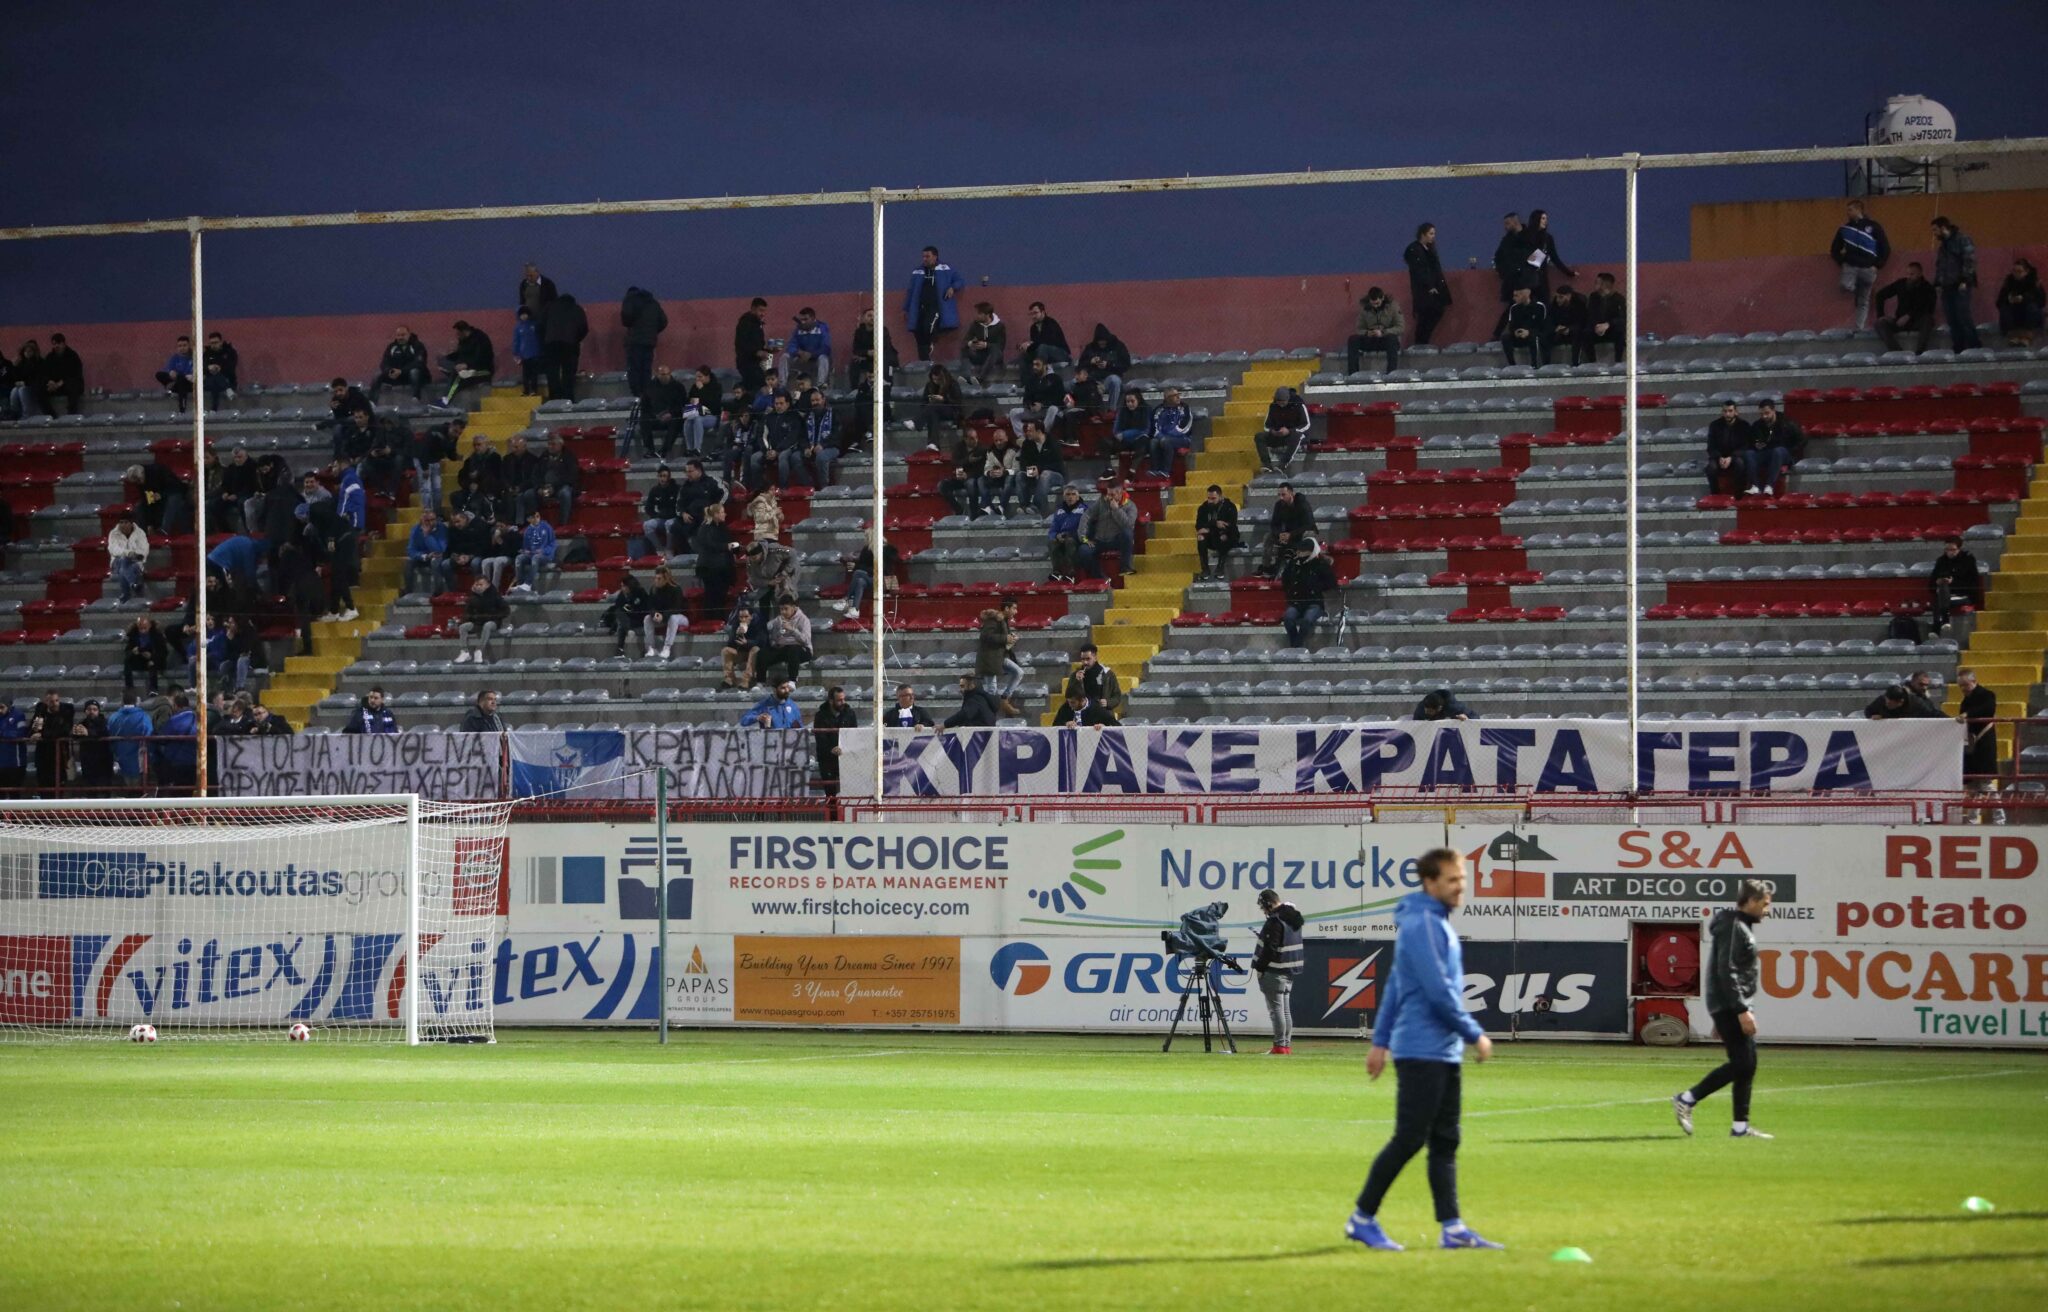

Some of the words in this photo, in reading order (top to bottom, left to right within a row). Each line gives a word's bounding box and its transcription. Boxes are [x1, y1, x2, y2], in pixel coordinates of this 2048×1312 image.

[883, 730, 1260, 796] ΚΥΡΙΑΚΕ
[1296, 728, 1598, 794] ΚΡΑΤΑ
[1638, 731, 1873, 796] ΓΕΡΑ
[730, 836, 1009, 870] FIRSTCHOICE
[1617, 830, 1754, 868] S&A
[1886, 835, 2039, 879] RED
[1161, 846, 1423, 890] Nordzucke
[730, 876, 810, 889] RECORDS
[816, 876, 827, 889] &
[834, 876, 877, 889] DATA
[883, 876, 1008, 889] MANAGEMENT
[1573, 878, 1616, 895] ART
[1626, 878, 1686, 895] DECO
[1695, 879, 1726, 896] CO
[752, 898, 969, 919] www.firstchoicecy.com
[1572, 906, 1647, 917] ΠΑΤΩΜΑΤΑ
[1652, 906, 1700, 918] ΠΑΡΚΕ
[1836, 896, 2027, 936] potato
[1319, 923, 1338, 932] best
[1343, 924, 1367, 934] sugar
[127, 937, 305, 1016] vitex
[420, 935, 604, 1018] vitex
[740, 953, 793, 976] Building
[797, 954, 829, 976] Your
[835, 954, 877, 971] Dreams
[880, 953, 915, 971] Since
[921, 956, 954, 971] 1997
[666, 977, 728, 994] PAPAS
[792, 984, 801, 998] 3
[805, 982, 839, 1004] Years
[845, 980, 904, 1004] Guarantee
[1463, 973, 1596, 1013] eus
[740, 1009, 845, 1018] www.npapasgroup.com
[886, 1010, 907, 1018] +357
[1110, 1005, 1133, 1022] air
[1914, 1006, 2007, 1036] Travel
